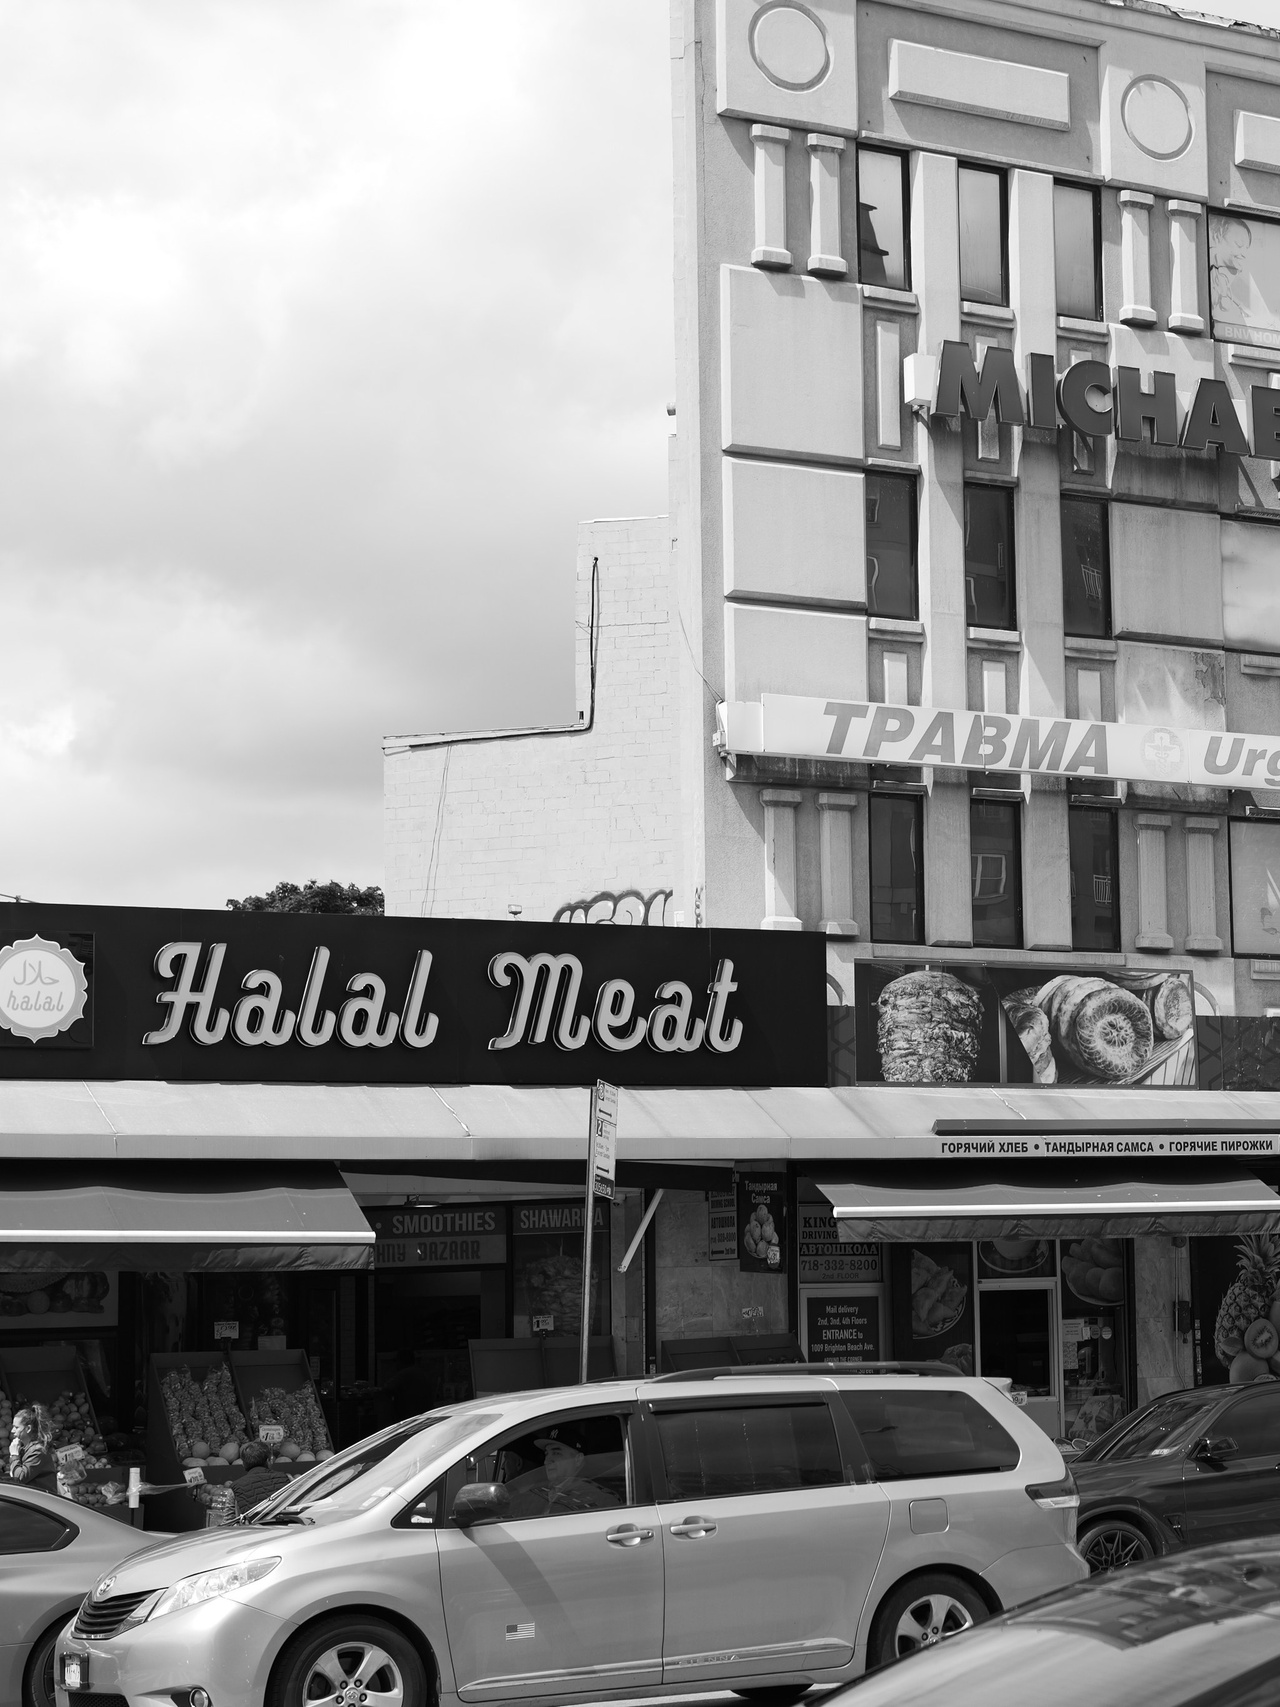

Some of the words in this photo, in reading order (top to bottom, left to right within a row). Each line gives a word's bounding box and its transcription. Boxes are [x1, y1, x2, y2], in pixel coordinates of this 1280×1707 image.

[822, 699, 1111, 778] ТРАВМА
[13, 959, 60, 986] حلال
[7, 990, 64, 1012] halal
[141, 941, 440, 1050] Halal
[487, 952, 745, 1053] Meat
[941, 1140, 995, 1153] ГОРЯЧИЙ
[998, 1142, 1028, 1153] ХЛЕБ
[1045, 1141, 1114, 1154] ТАНДЫРНАЯ
[1116, 1142, 1154, 1153] САМСА
[1169, 1141, 1218, 1153] ГОРЯЧИЕ
[1220, 1139, 1273, 1152] ПИРОЖКИ
[744, 1180, 778, 1193] Тандырная
[392, 1211, 496, 1234] SMOOTHIES
[520, 1207, 604, 1229] SHAWARA
[802, 1217, 838, 1228] KING
[802, 1231, 838, 1240] DRIVING
[417, 1240, 481, 1262] BAZAAR
[800, 1243, 878, 1255] АВТОШКОЛА
[801, 1259, 877, 1271] 718-332-8200
[837, 1272, 860, 1280] FLOOR
[825, 1305, 837, 1314] Mail
[838, 1305, 859, 1315] delivery
[842, 1317, 851, 1326] 4th
[851, 1317, 867, 1325] Floors
[822, 1329, 857, 1340] ENTRANCE
[857, 1331, 863, 1339] to
[811, 1344, 824, 1353] 1009
[824, 1343, 846, 1354] Brighton
[846, 1343, 863, 1352] Beach
[863, 1343, 875, 1351] Ave.
